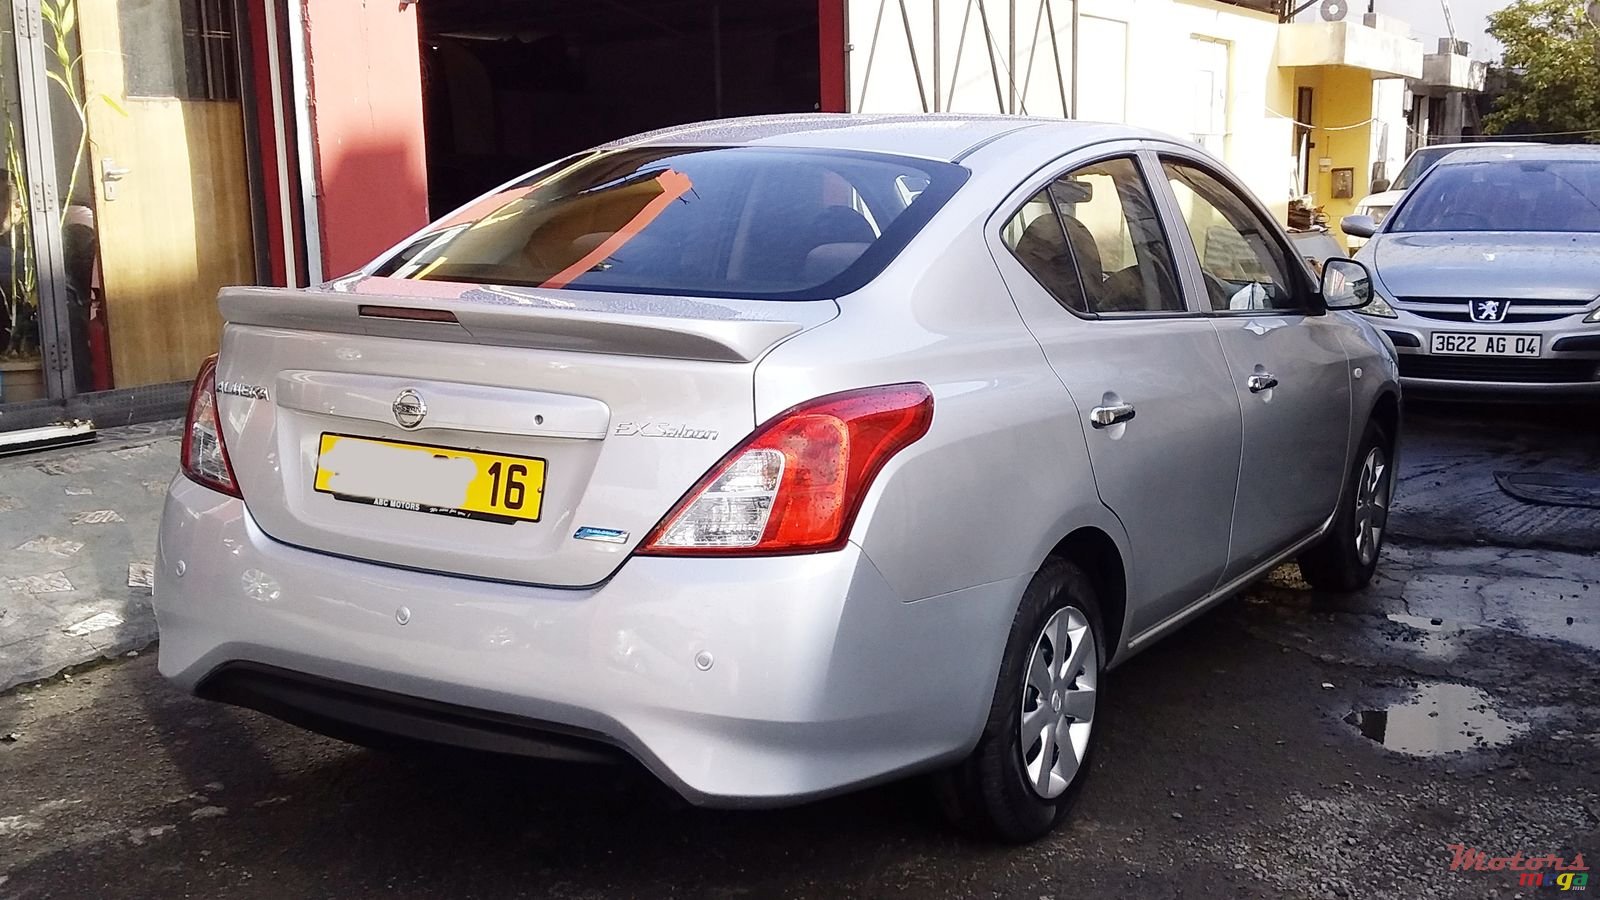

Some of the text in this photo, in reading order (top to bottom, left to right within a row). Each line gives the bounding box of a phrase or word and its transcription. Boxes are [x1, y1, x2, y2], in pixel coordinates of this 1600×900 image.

[1435, 335, 1536, 354] 3622 AG 04
[614, 422, 719, 441] EX Saloon
[487, 461, 528, 510] 16
[373, 498, 420, 511] ABC MOTORS
